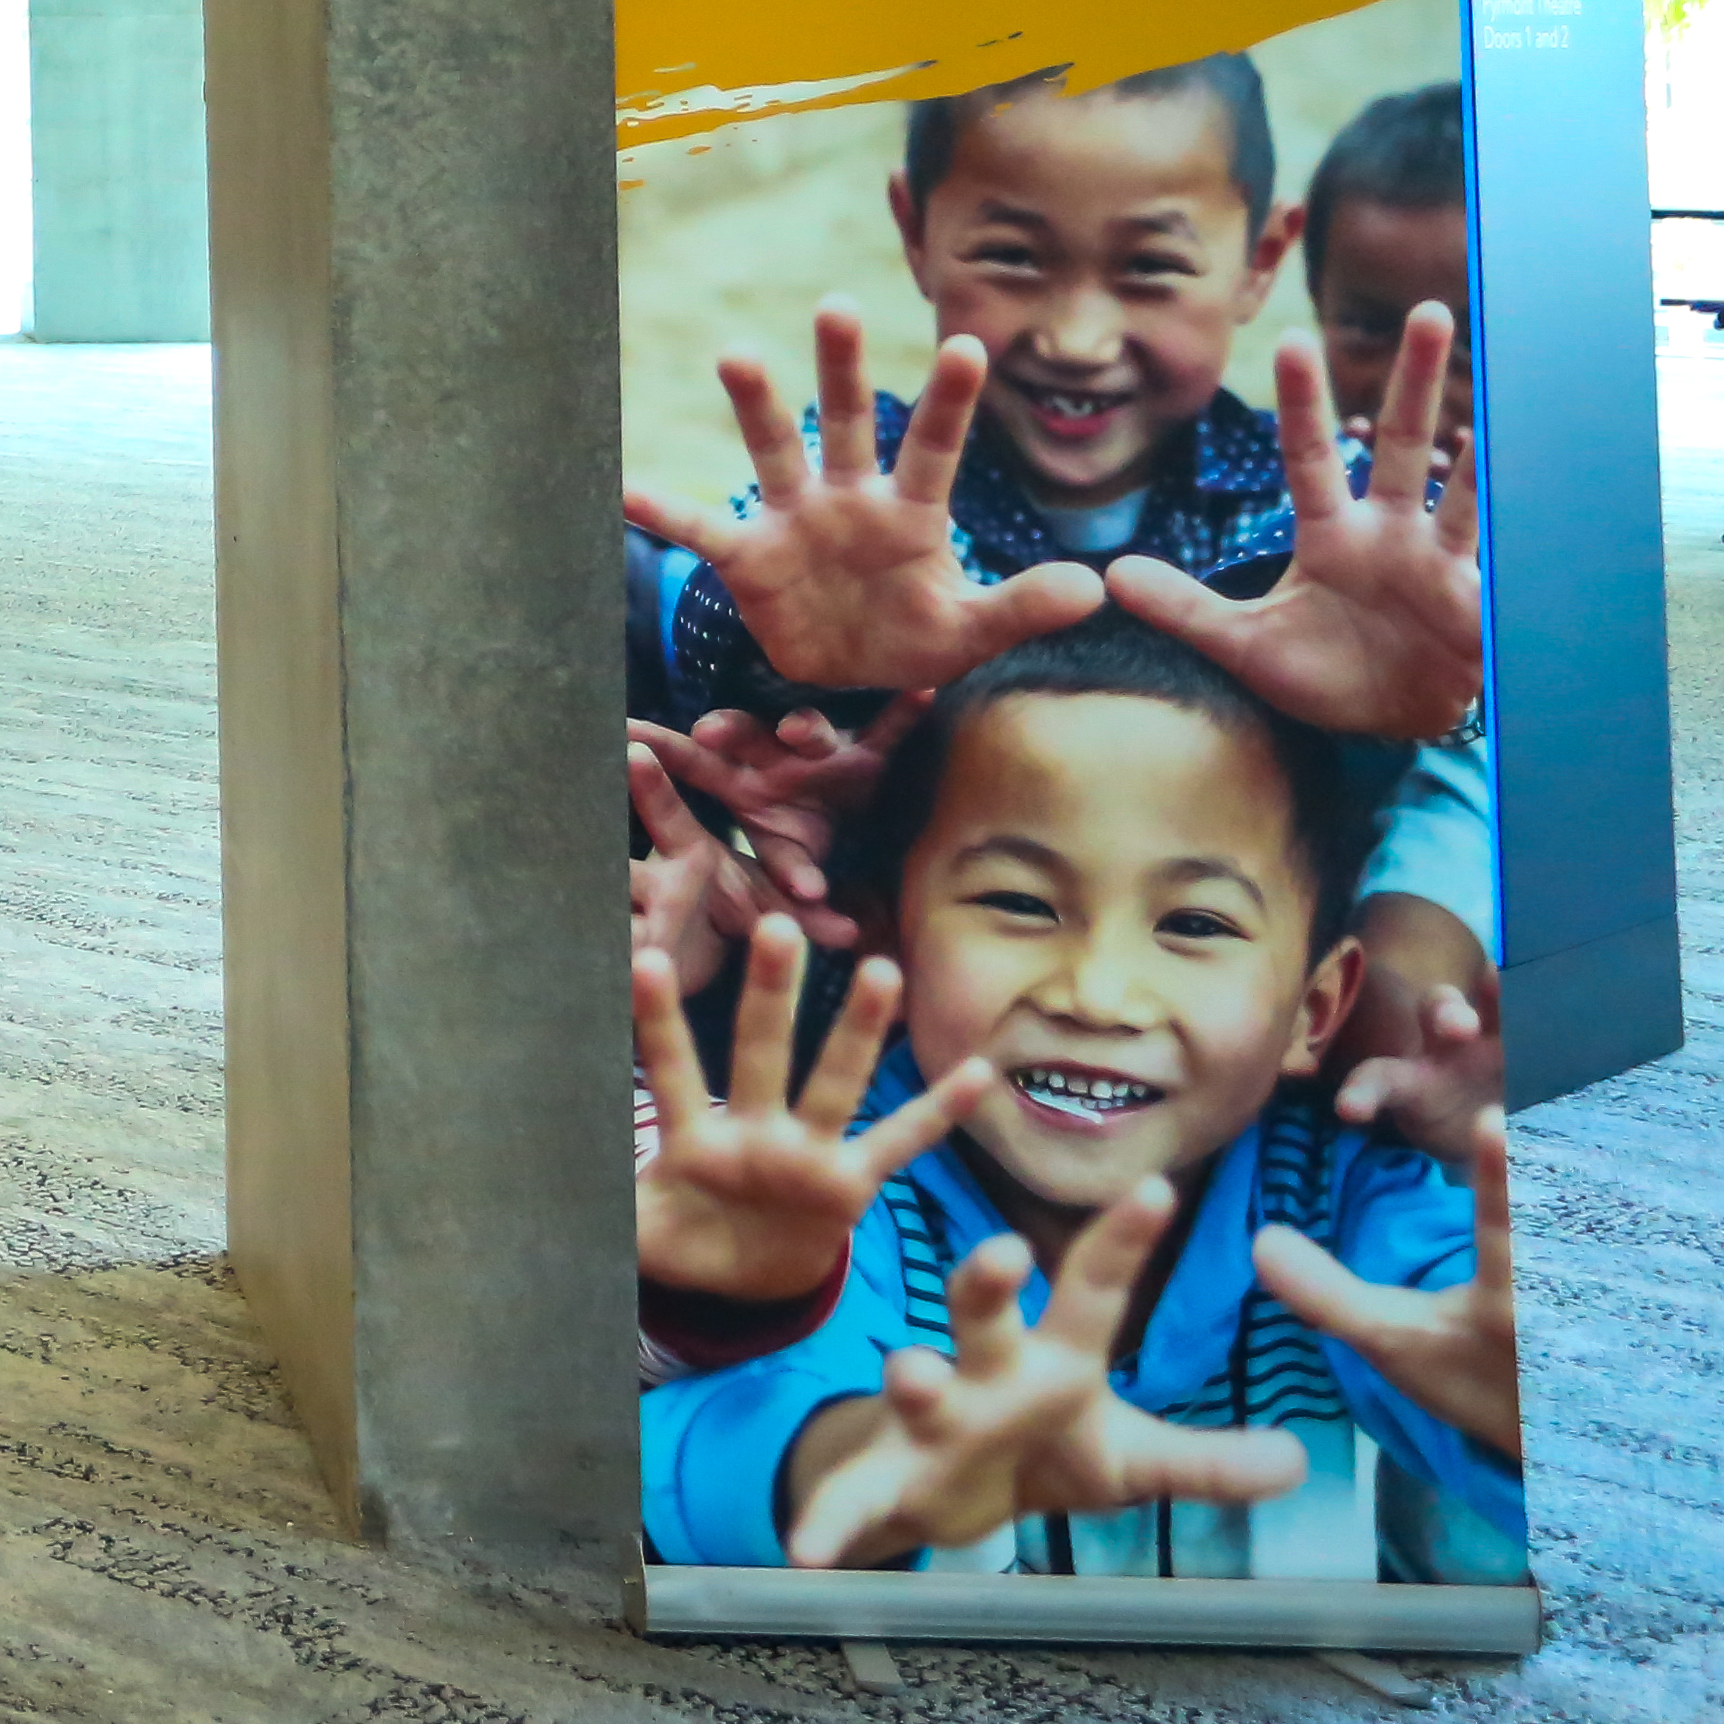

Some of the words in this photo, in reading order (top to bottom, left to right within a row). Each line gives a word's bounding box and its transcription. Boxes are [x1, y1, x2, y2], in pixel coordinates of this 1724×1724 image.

[1484, 25, 1521, 49] Doors
[1535, 25, 1558, 49] and
[1561, 24, 1570, 48] 2
